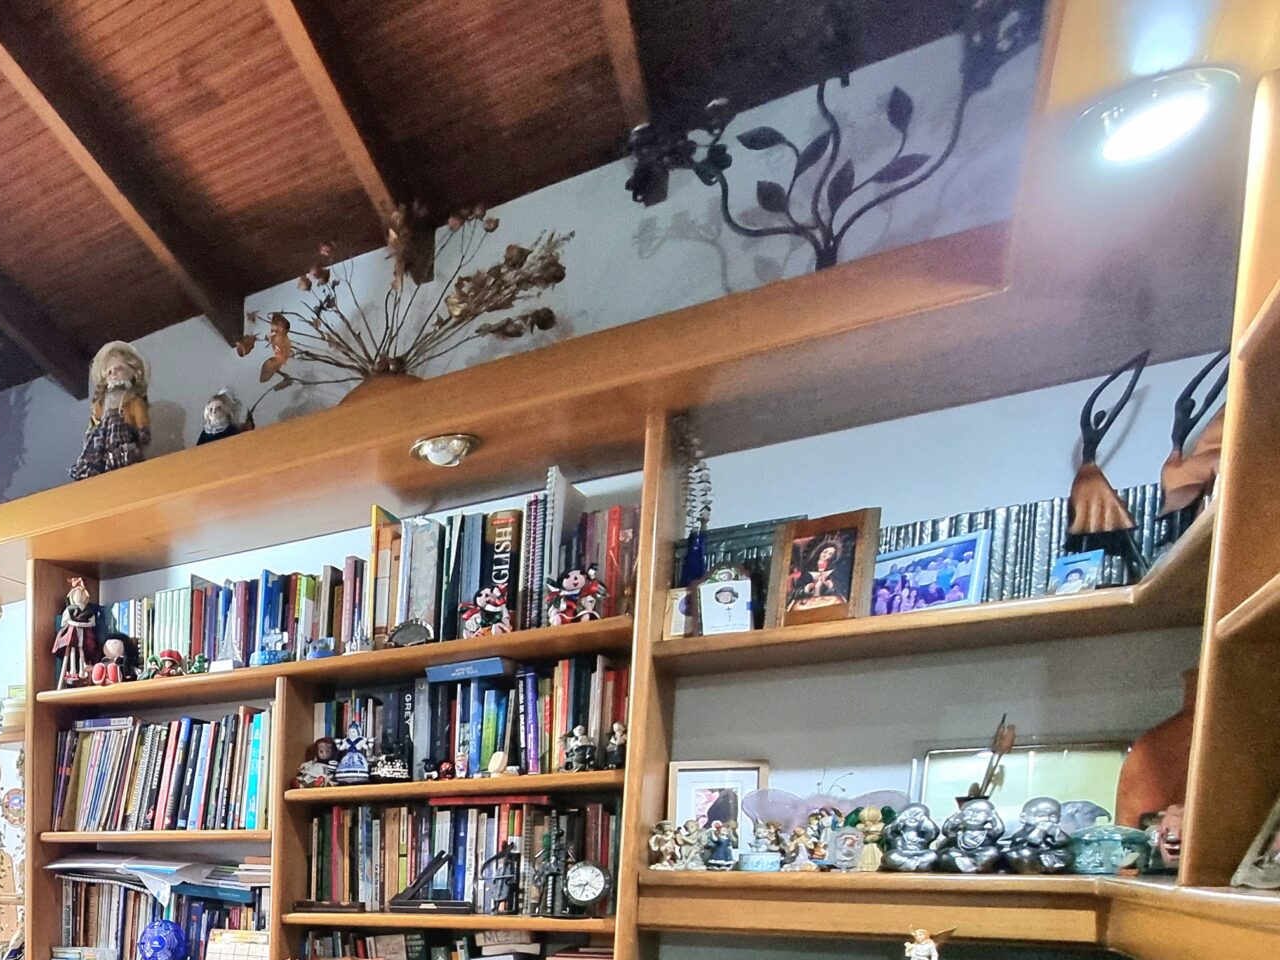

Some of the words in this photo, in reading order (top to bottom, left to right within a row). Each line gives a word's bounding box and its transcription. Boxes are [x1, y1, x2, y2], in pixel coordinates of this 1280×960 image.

[492, 526, 513, 584] GLISH
[404, 693, 412, 726] GREY
[152, 750, 163, 789] NATURALEZA
